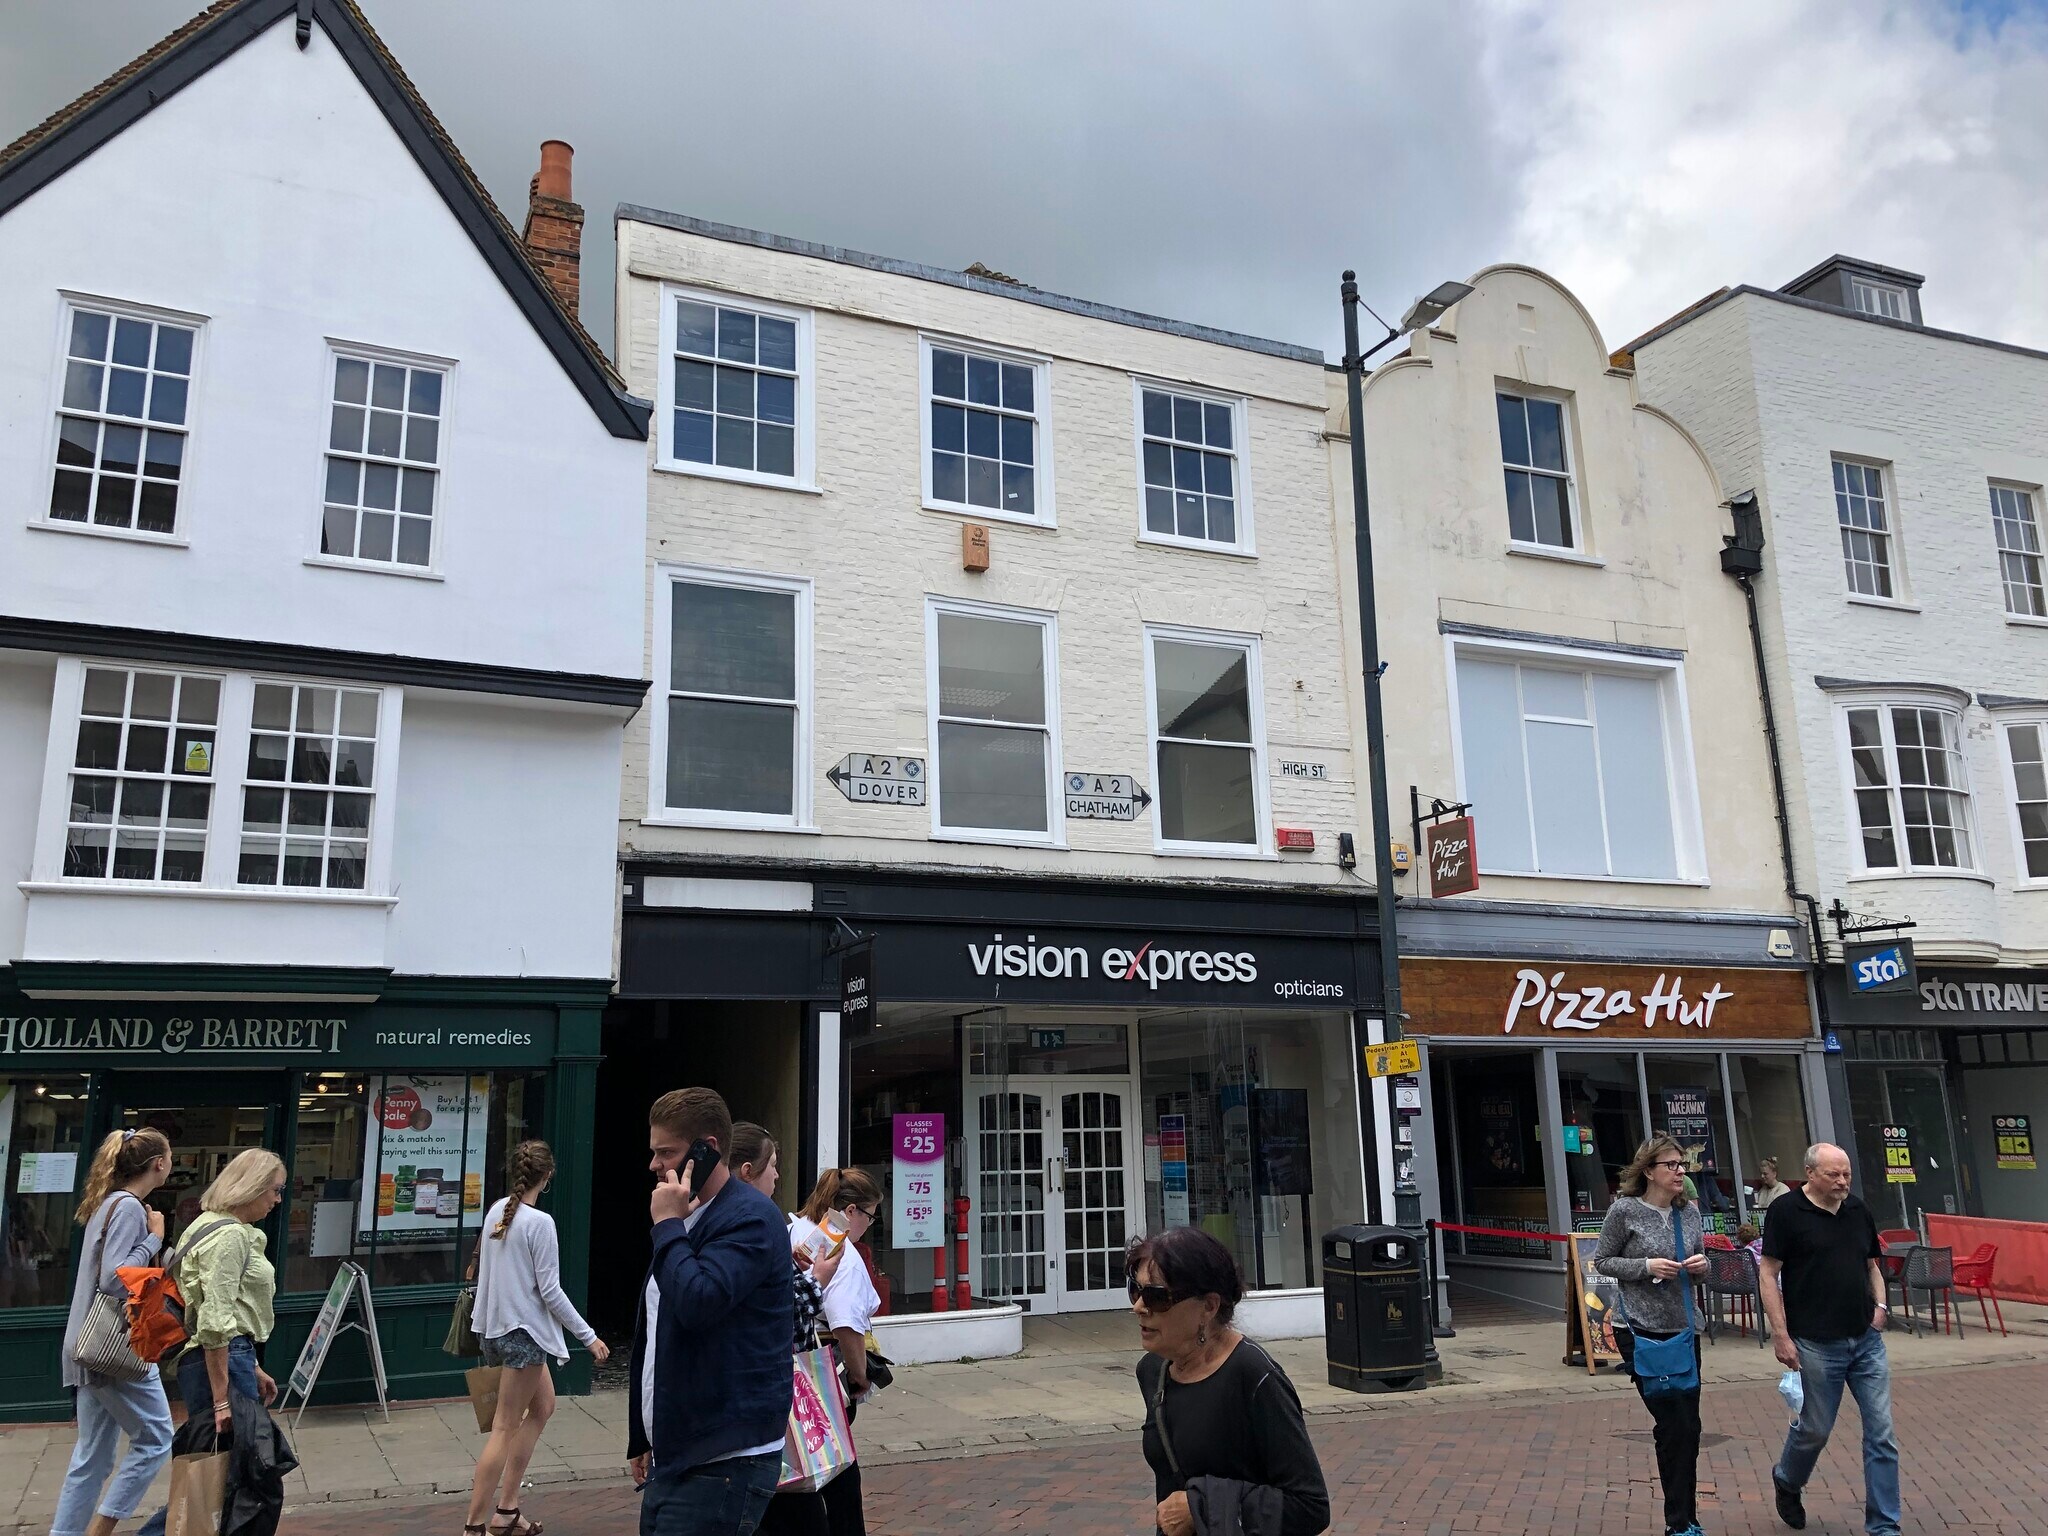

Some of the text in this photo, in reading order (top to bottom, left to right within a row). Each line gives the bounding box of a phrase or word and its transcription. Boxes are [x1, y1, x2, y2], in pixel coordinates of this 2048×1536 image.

[863, 759, 891, 775] A 2
[1282, 763, 1323, 777] HIGH ST
[858, 783, 918, 799] DOVER
[1094, 778, 1121, 793] A 2
[1069, 800, 1131, 814] CHATHAM
[1431, 838, 1468, 863] Pizza
[1437, 859, 1465, 881] Hut
[968, 933, 1258, 990] vision express
[1893, 947, 1908, 975] TRAVEL
[1858, 956, 1900, 984] sta
[847, 976, 865, 994] vision
[1274, 979, 1344, 998] opticians
[1504, 968, 1734, 1033] Pizza Hut
[1919, 976, 1965, 1011] sta
[843, 995, 868, 1015] express
[0, 1017, 347, 1054] HOLLAND & BARRETT
[376, 1028, 531, 1045] natural remedies
[1366, 1045, 1399, 1054] Pedestrian
[437, 1095, 453, 1105] Buy
[460, 1096, 473, 1105] gt
[437, 1104, 449, 1112] for
[1666, 1101, 1706, 1115] TAKEAWAY
[397, 1134, 404, 1142] &
[903, 1136, 936, 1154] £25
[382, 1147, 408, 1158] taying
[409, 1146, 425, 1155] well
[427, 1146, 443, 1155] this
[908, 1181, 931, 1195] £75
[906, 1206, 933, 1220] £5.95
[1523, 1220, 1549, 1234] Pizza
